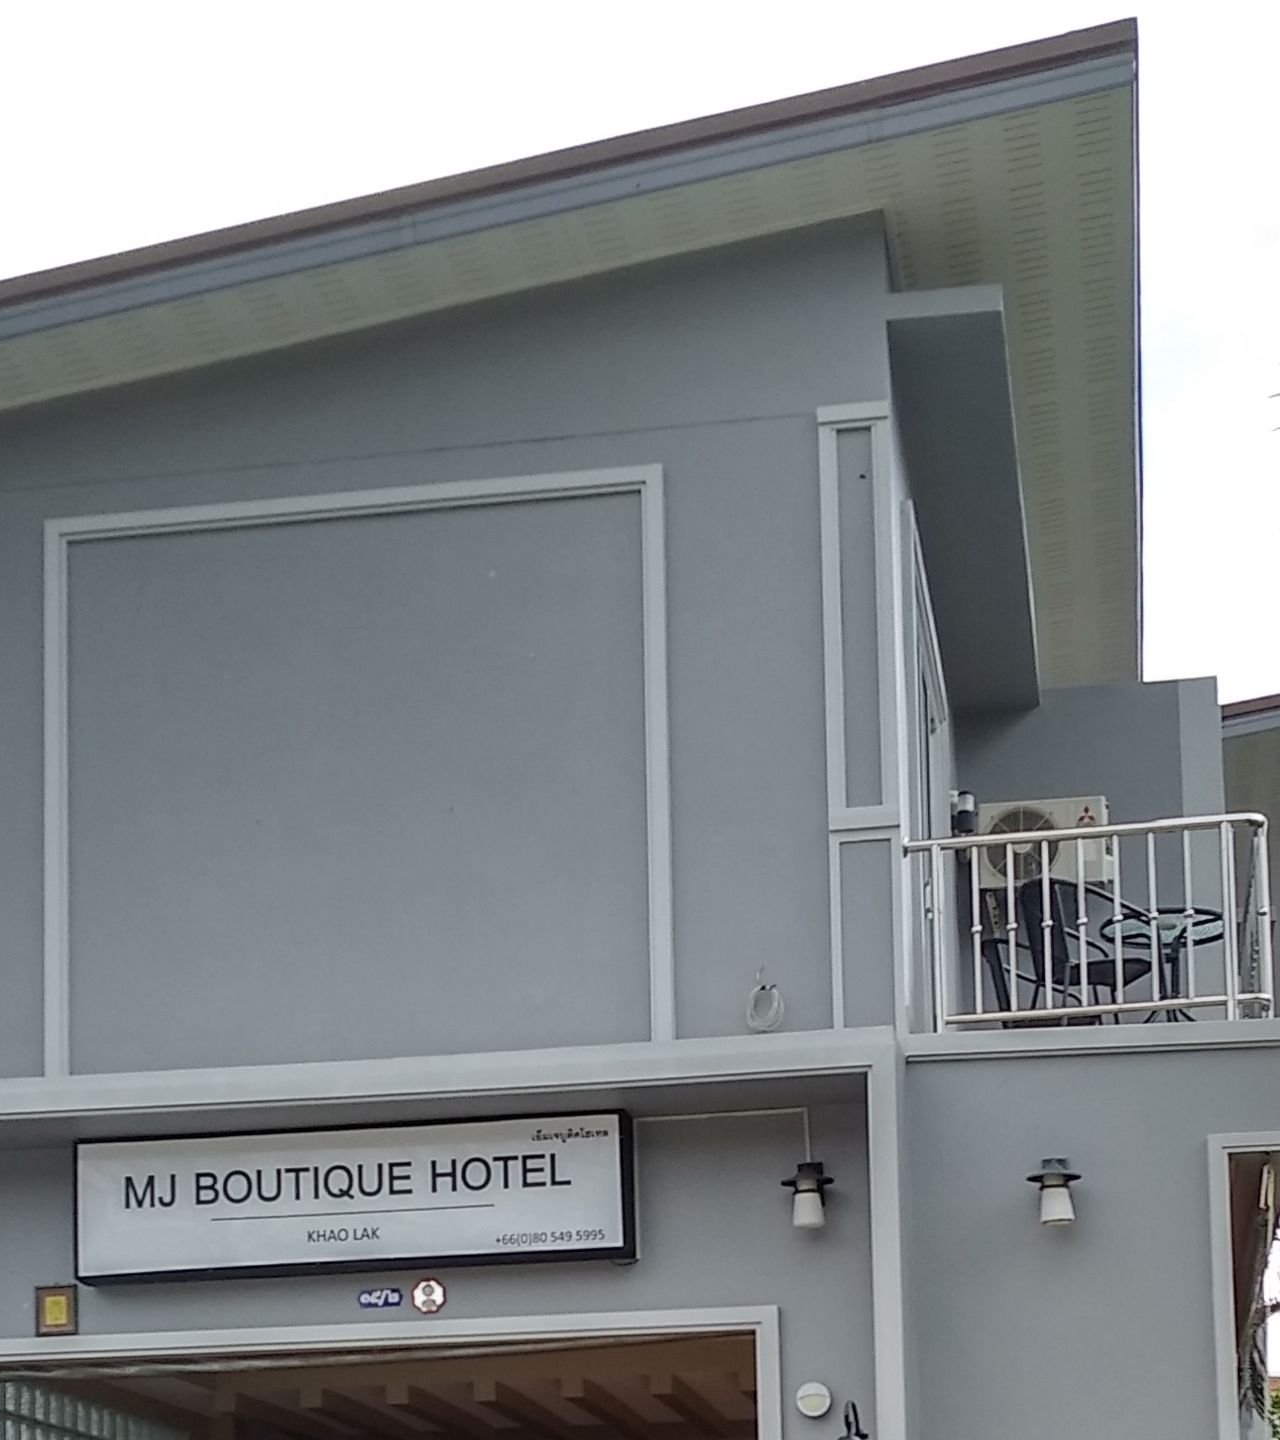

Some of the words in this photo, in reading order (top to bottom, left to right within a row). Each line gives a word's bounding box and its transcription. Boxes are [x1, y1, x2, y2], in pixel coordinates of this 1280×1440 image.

[124, 1174, 177, 1209] MJ
[194, 1161, 413, 1206] BOUTIQUE
[430, 1153, 572, 1193] HOTEL
[307, 1228, 349, 1242] KHAO
[353, 1227, 380, 1241] LAK
[495, 1232, 548, 1246] +66(0)80
[550, 1231, 572, 1242] 549
[575, 1229, 605, 1241] 5995
